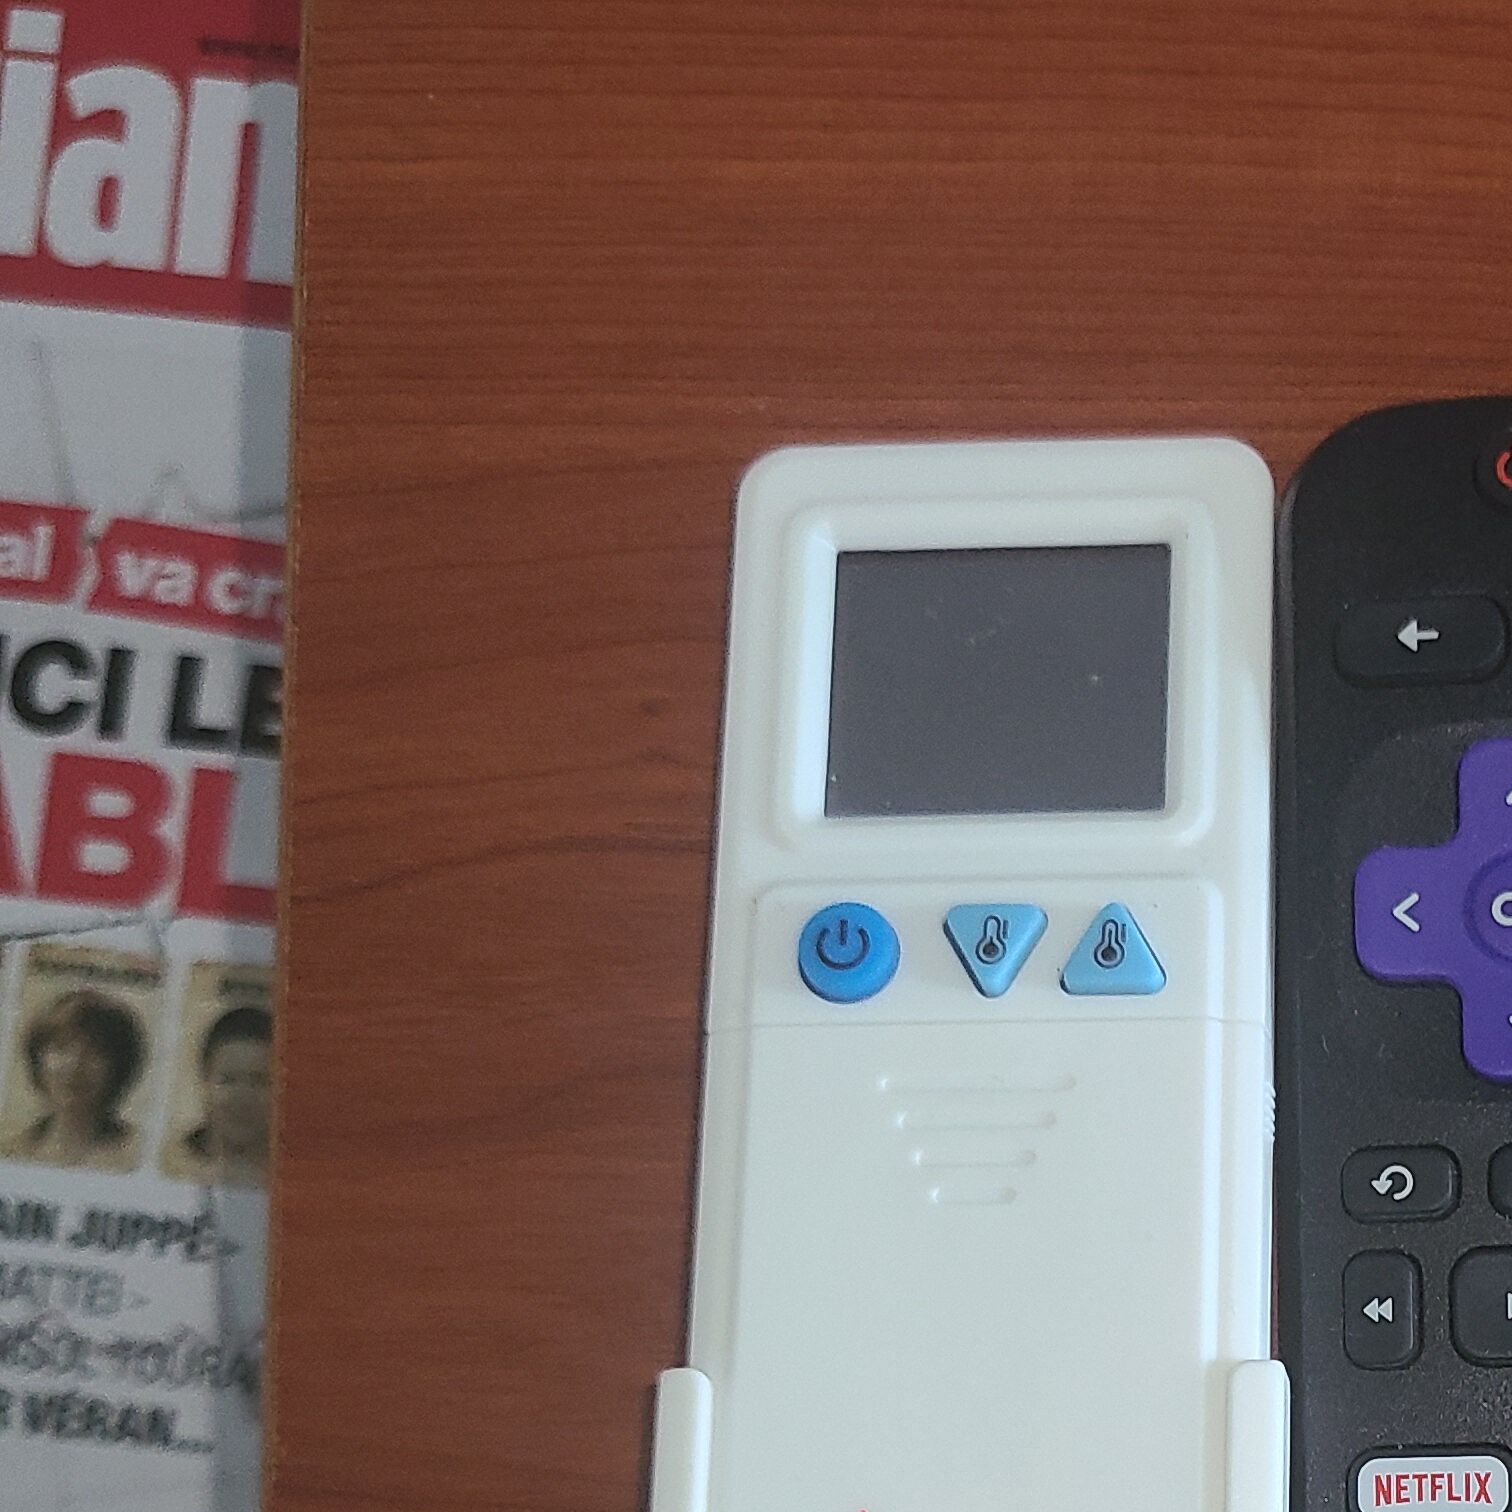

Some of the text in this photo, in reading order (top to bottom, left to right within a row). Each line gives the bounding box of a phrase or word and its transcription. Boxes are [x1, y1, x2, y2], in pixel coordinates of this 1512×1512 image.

[0, 632, 135, 743] CI
[0, 745, 280, 924] BL
[1374, 1472, 1493, 1507] NETFLIX
